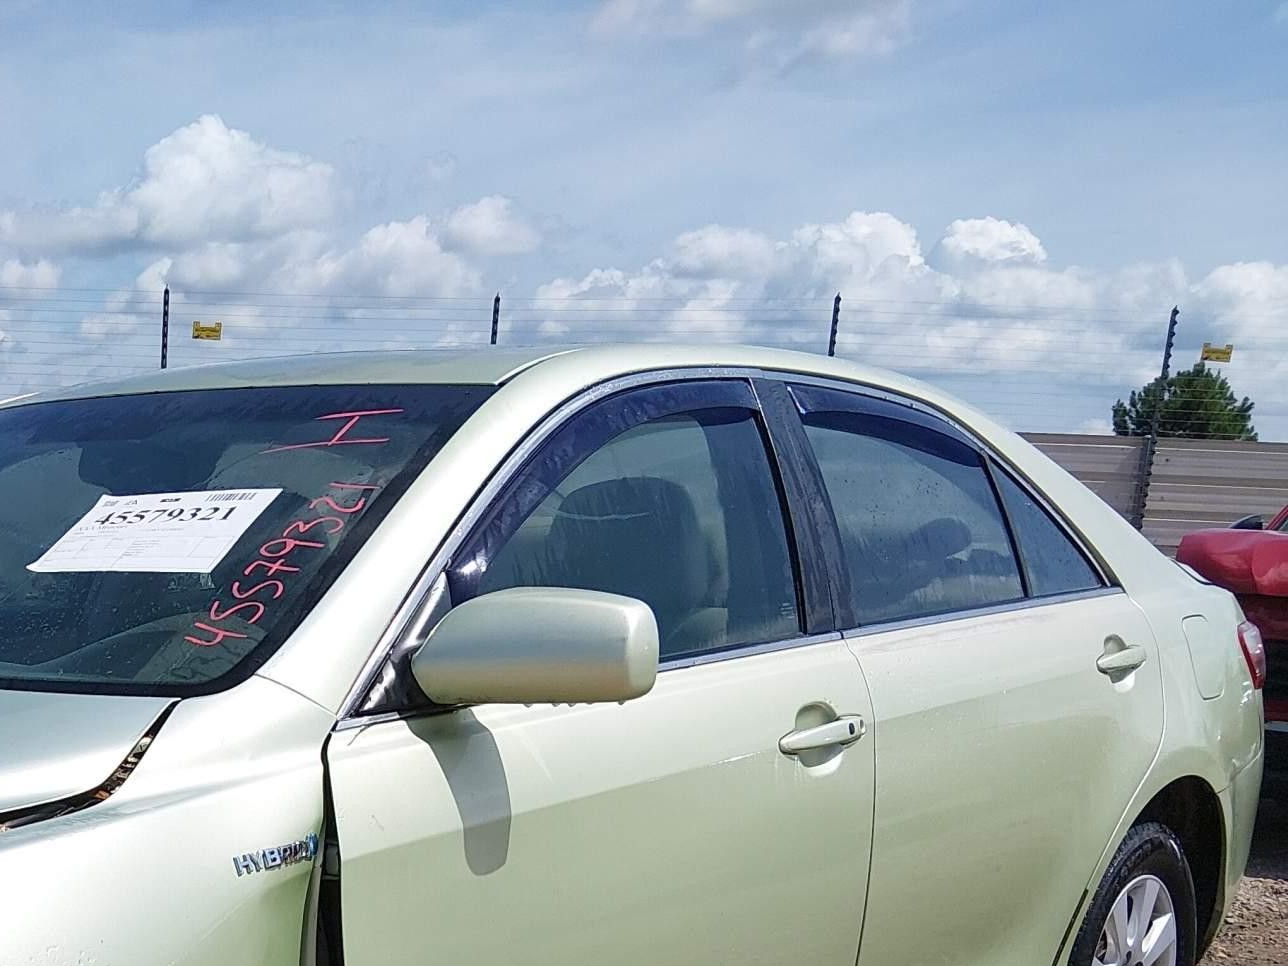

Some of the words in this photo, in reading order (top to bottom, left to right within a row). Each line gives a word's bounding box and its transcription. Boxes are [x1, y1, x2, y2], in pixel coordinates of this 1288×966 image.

[95, 506, 238, 525] 45579321
[185, 481, 381, 648] 45579321
[233, 840, 312, 877] HYBRID
